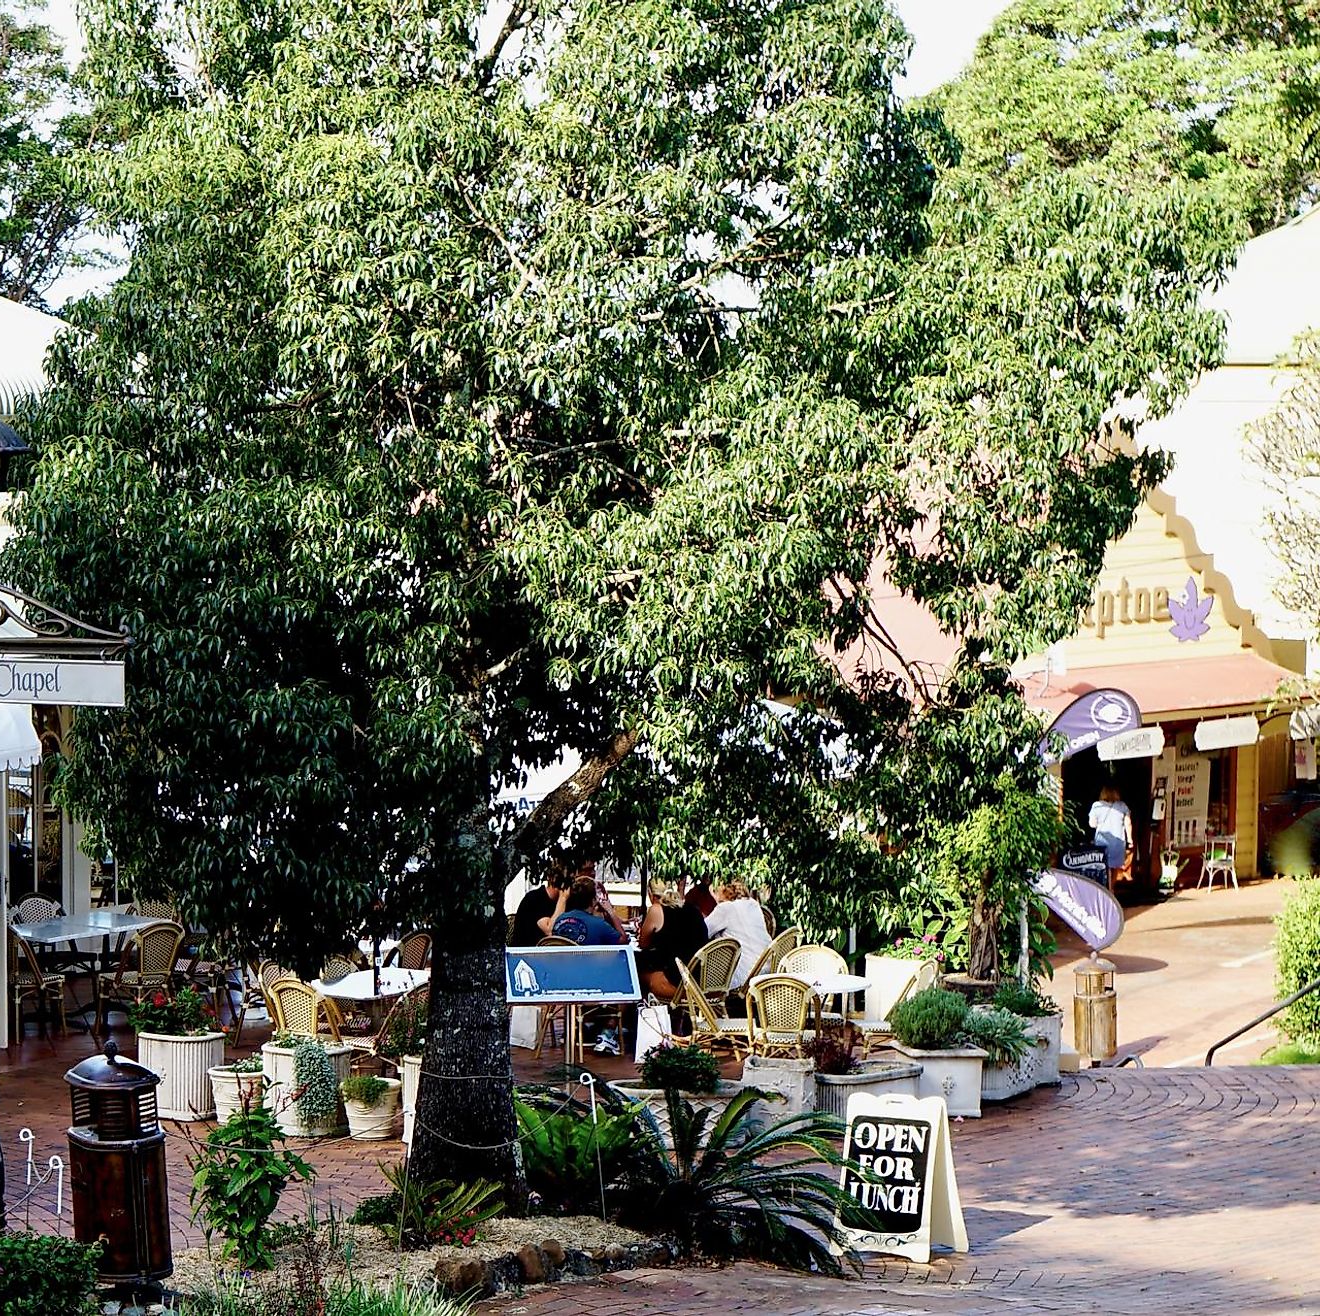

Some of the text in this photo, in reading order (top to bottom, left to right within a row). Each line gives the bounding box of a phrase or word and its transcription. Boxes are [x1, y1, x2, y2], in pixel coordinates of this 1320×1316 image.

[854, 1122, 928, 1153] OPEN
[858, 1154, 915, 1181] FOR
[848, 1179, 922, 1215] LUNCH
